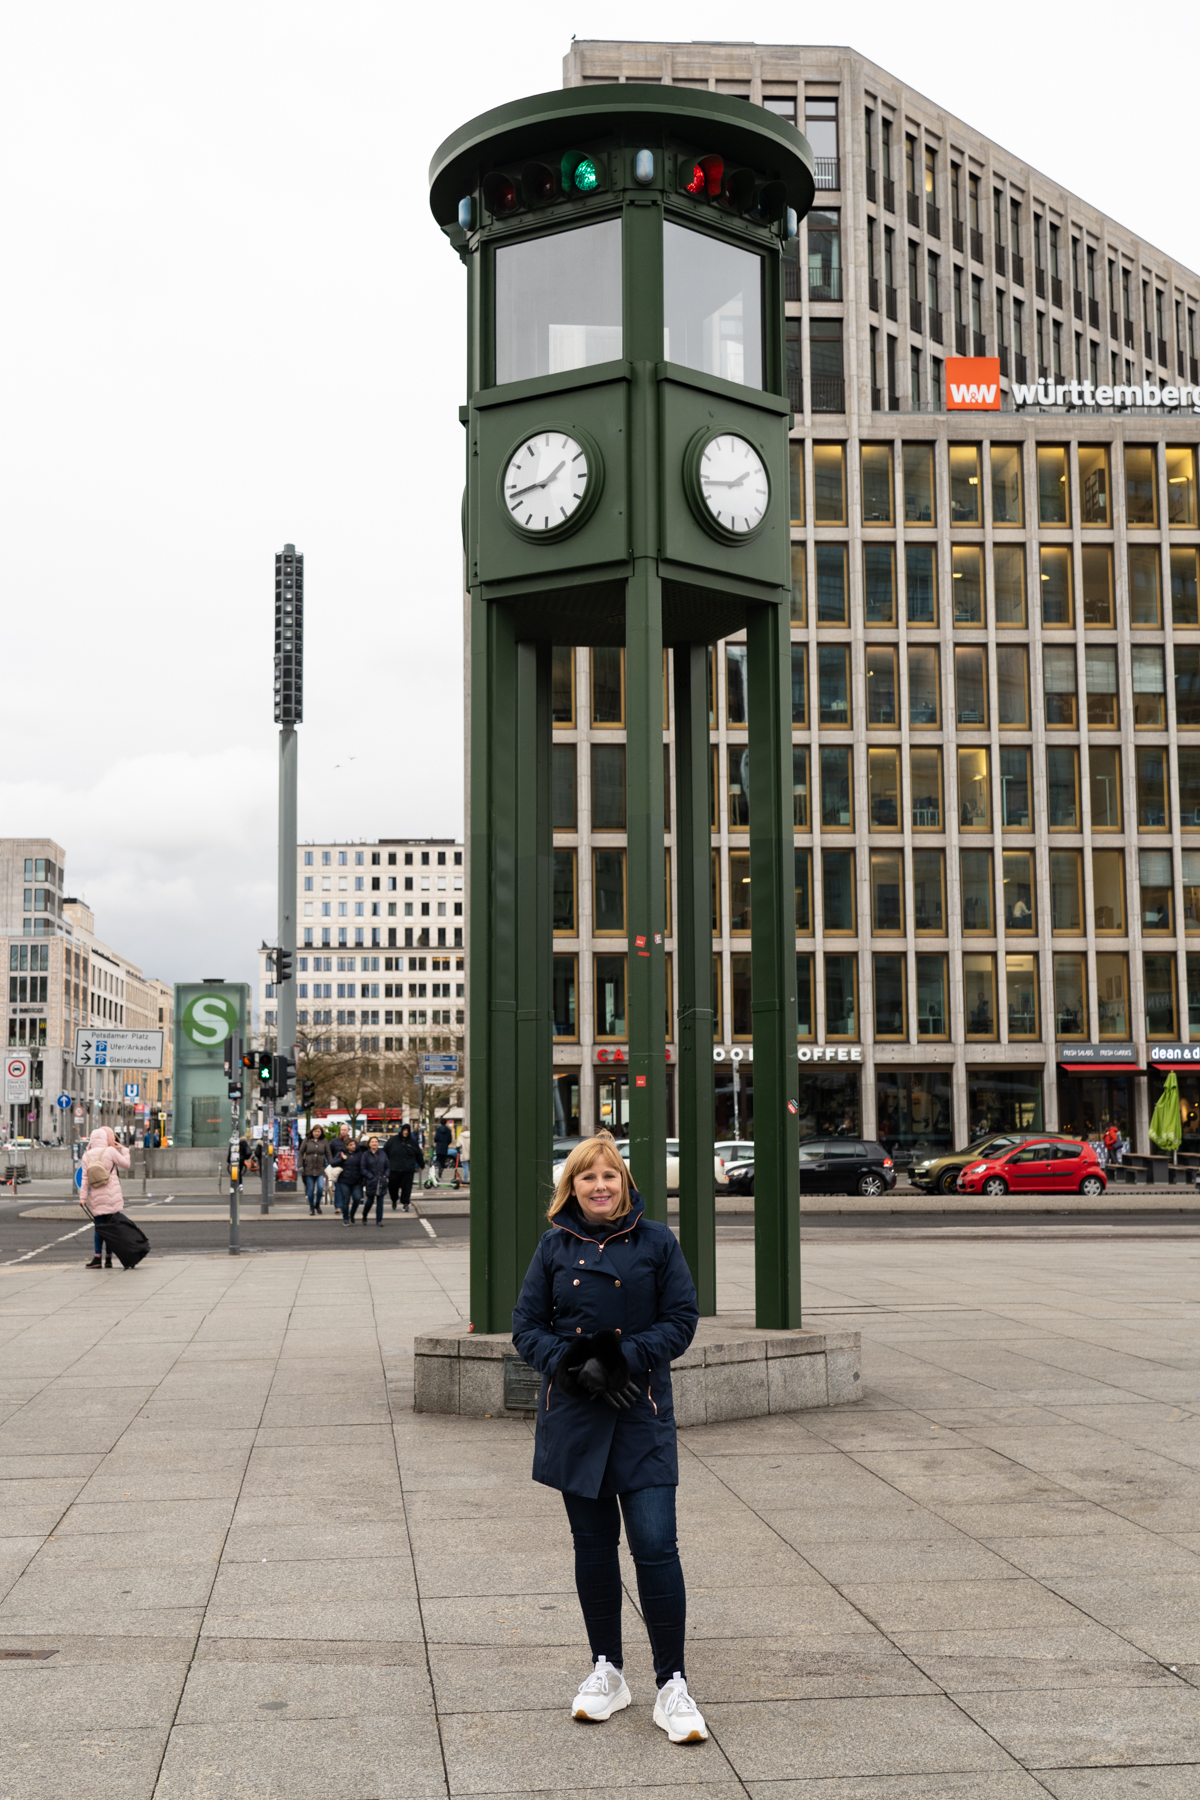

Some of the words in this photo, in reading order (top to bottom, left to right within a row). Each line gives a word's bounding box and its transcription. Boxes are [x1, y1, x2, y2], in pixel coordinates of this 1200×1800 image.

[949, 383, 998, 404] W&W
[192, 997, 229, 1045] S
[110, 1043, 157, 1051] Ufer/Arkaden
[1151, 1046, 1182, 1060] dean
[109, 1056, 152, 1064] Gleisdreieck
[597, 1049, 671, 1062] CAS
[713, 1047, 753, 1062] OO
[797, 1047, 861, 1062] OFFEE
[127, 1084, 138, 1097] U
